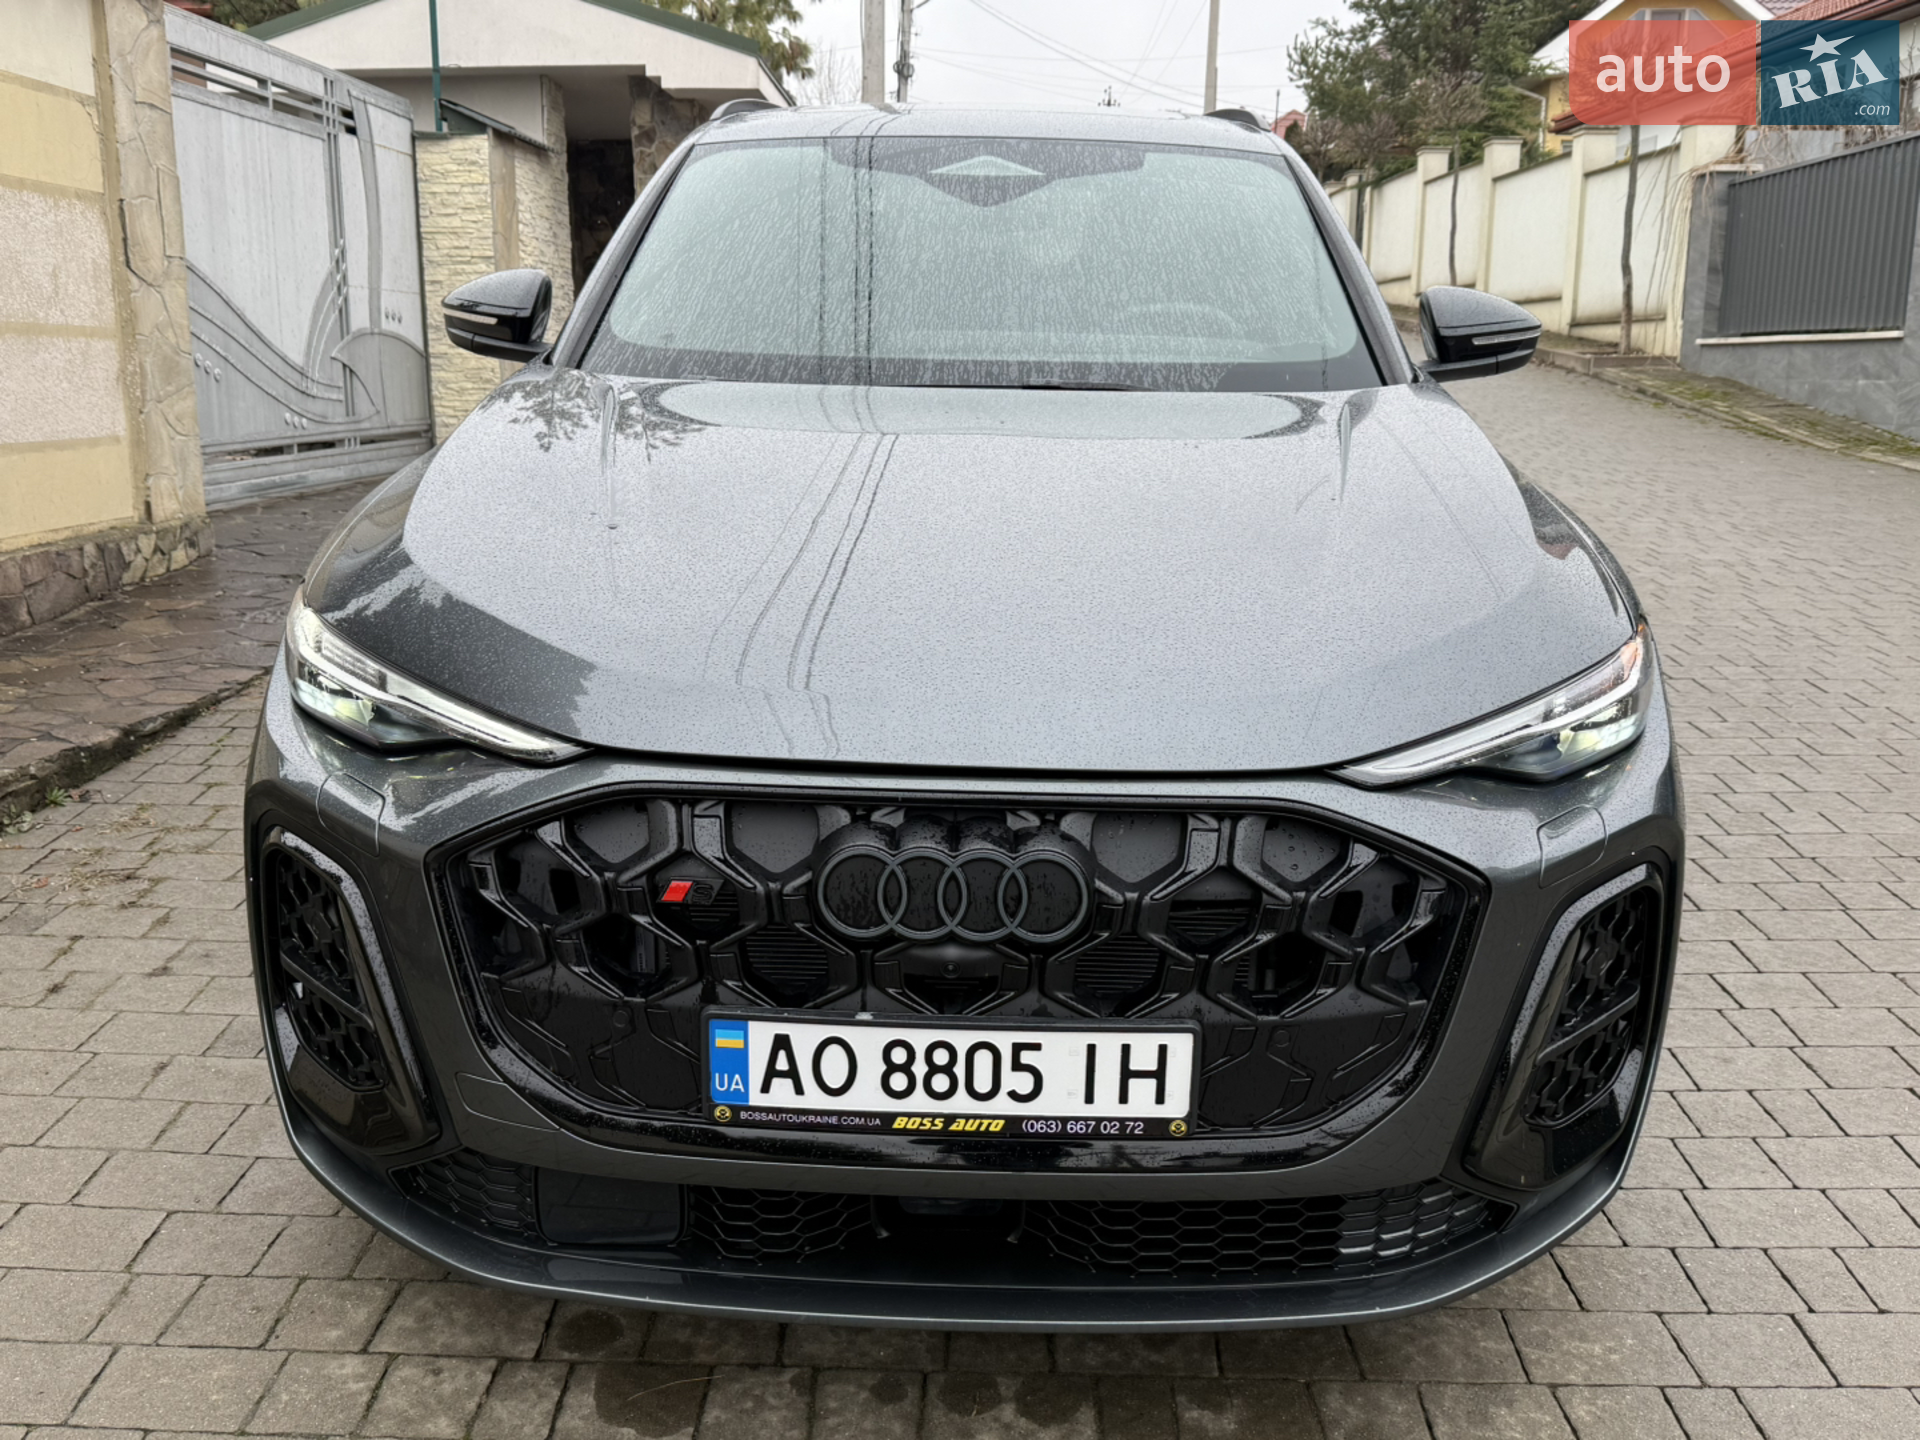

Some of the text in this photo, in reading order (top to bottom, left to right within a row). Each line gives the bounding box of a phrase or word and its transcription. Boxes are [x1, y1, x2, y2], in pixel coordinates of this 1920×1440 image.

[759, 1032, 1170, 1105] AO 8805 IH
[714, 1073, 745, 1094] UA
[740, 1111, 1144, 1135] BOSSAUTOUKRAINE.COM.UA BOSS AUTO (063) 667 02 72
